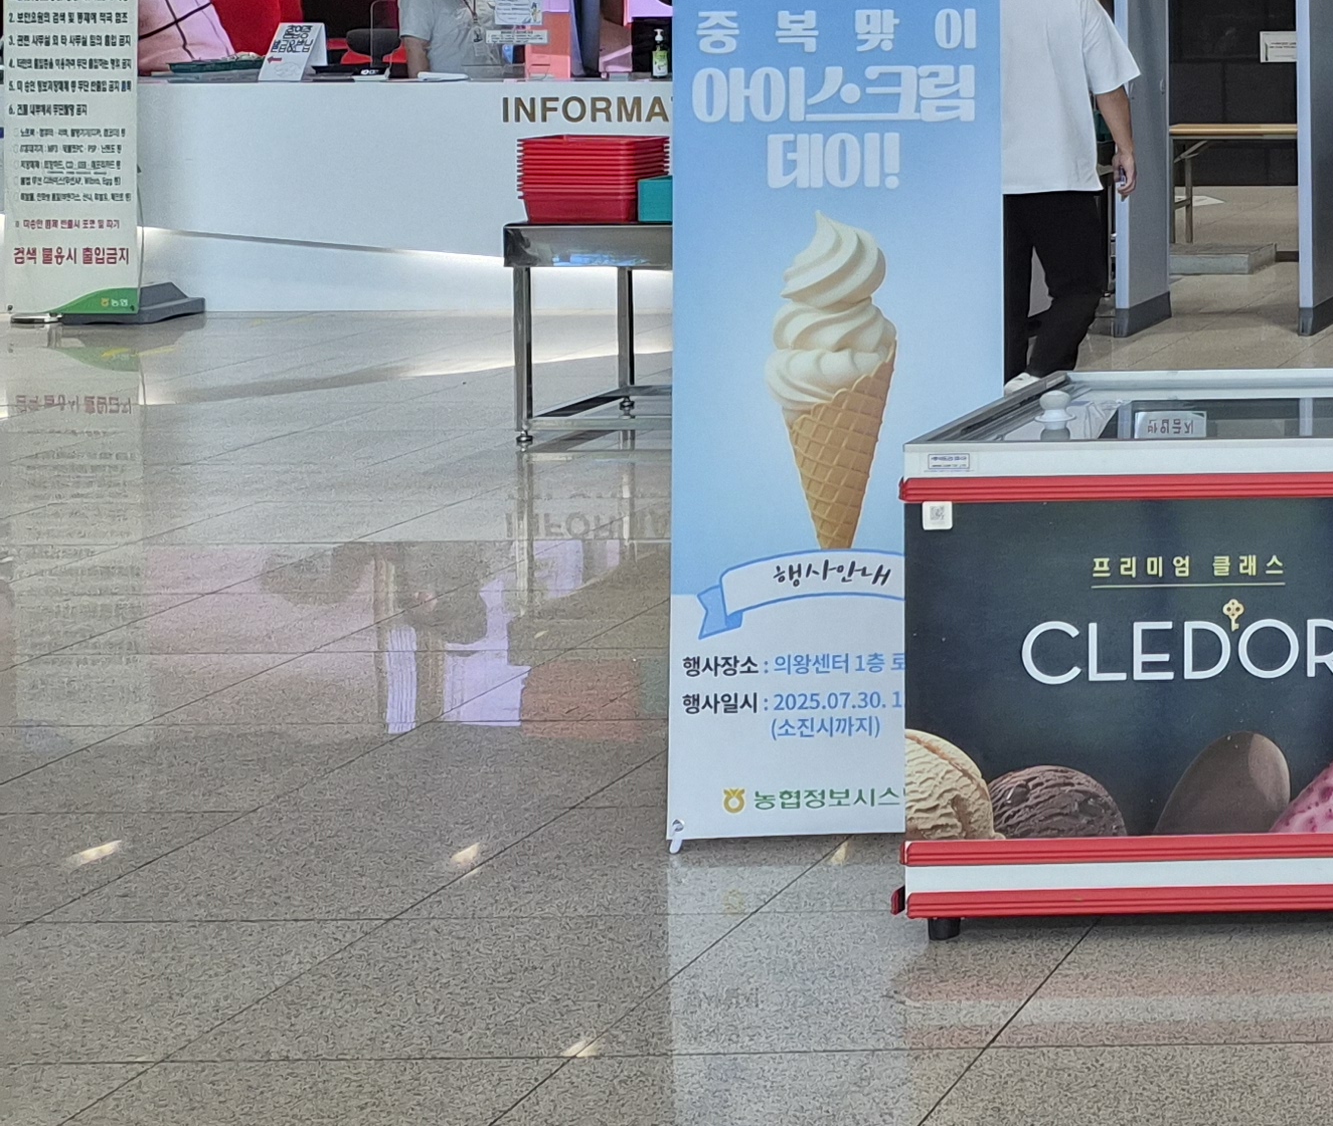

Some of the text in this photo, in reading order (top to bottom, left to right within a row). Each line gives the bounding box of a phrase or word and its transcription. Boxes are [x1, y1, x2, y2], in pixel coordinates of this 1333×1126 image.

[692, 65, 976, 123] 아이스크림
[502, 96, 674, 123] INFORMA
[766, 131, 901, 189] 데이!
[14, 247, 129, 266] 검색 불응시 출입금지
[773, 559, 892, 587] 행사안내
[1092, 554, 1284, 578] 프리미엄 클래스
[682, 655, 759, 677] 행사장소
[773, 653, 850, 675] 의왕센터
[855, 653, 886, 674] 1층
[682, 691, 887, 715] 행사일시 2025.07.30.
[771, 715, 881, 741] (소진시까지)
[754, 788, 906, 812] 농협정보시스
